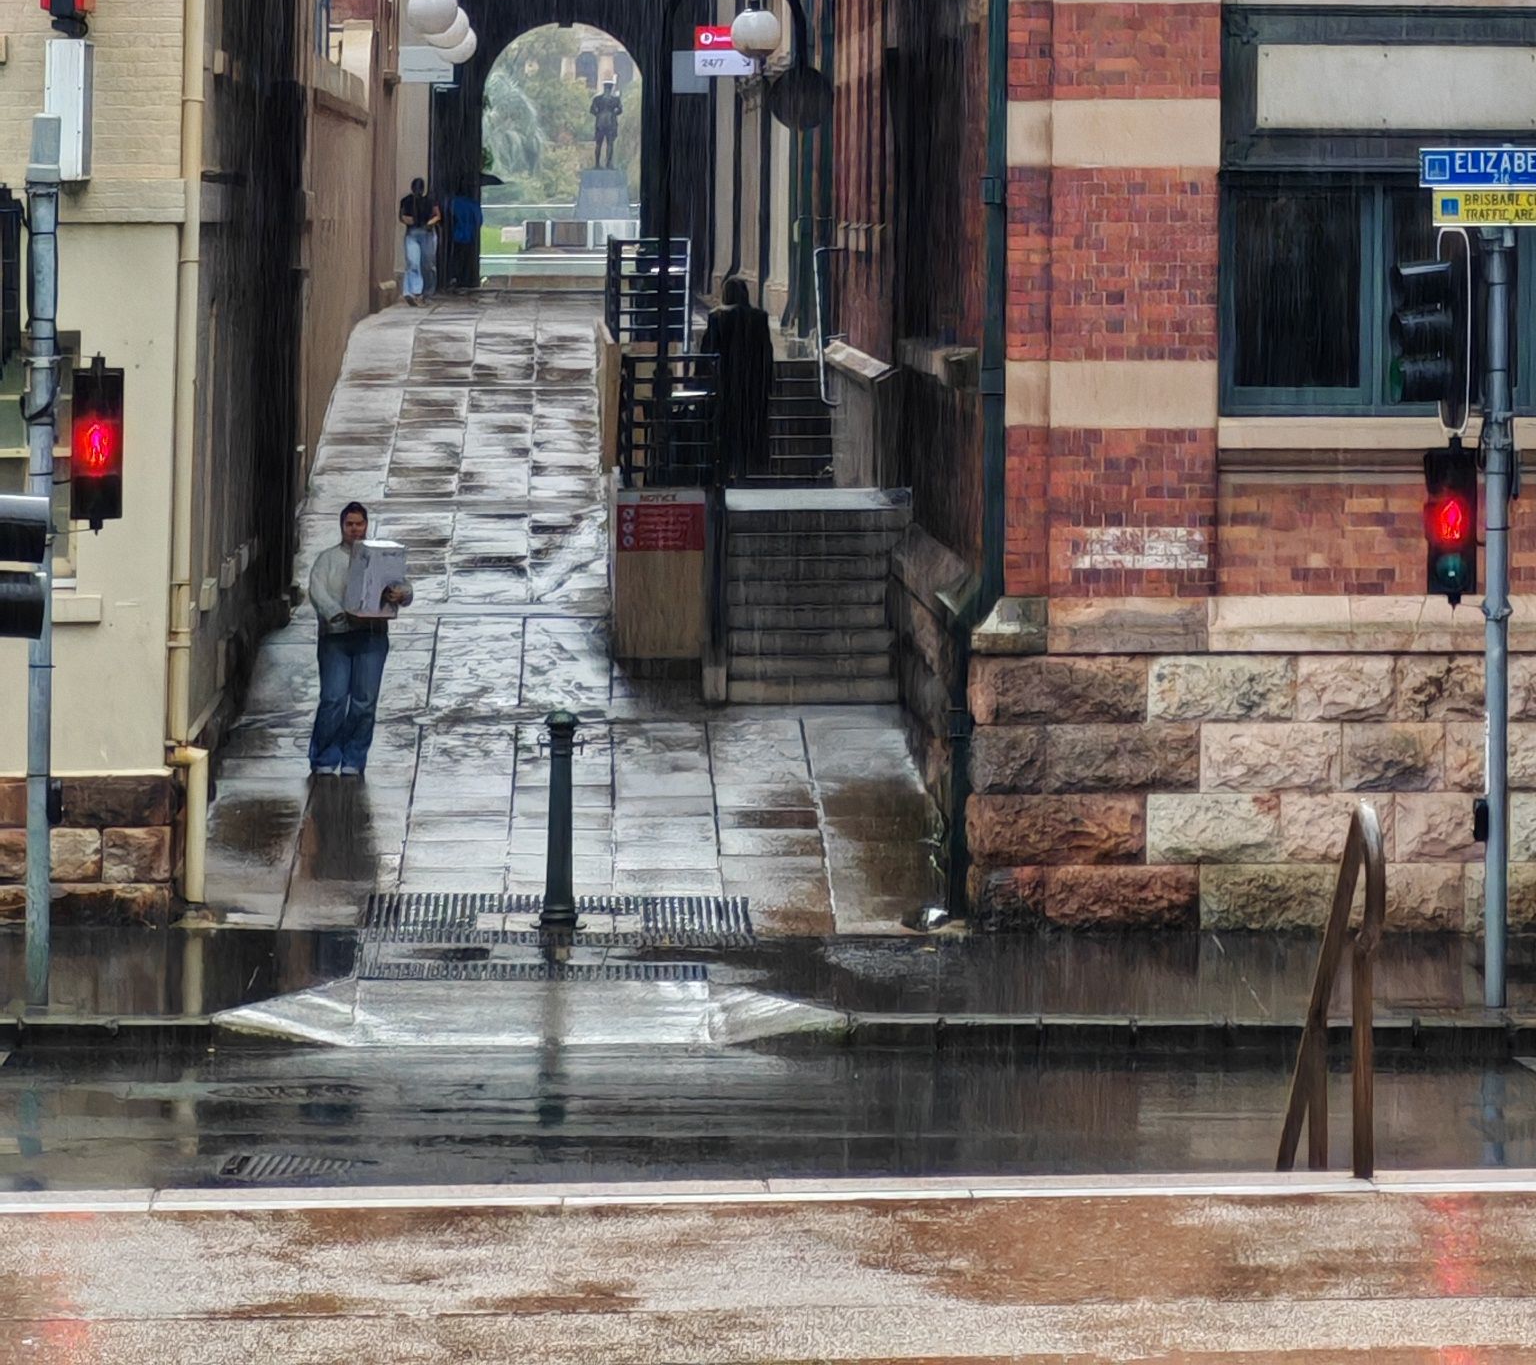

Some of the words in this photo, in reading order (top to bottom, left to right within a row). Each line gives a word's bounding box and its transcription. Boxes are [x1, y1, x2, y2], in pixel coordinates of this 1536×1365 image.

[702, 59, 724, 68] 24/7
[1464, 194, 1521, 206] BRISBANE
[1464, 209, 1509, 221] TRAFFIC
